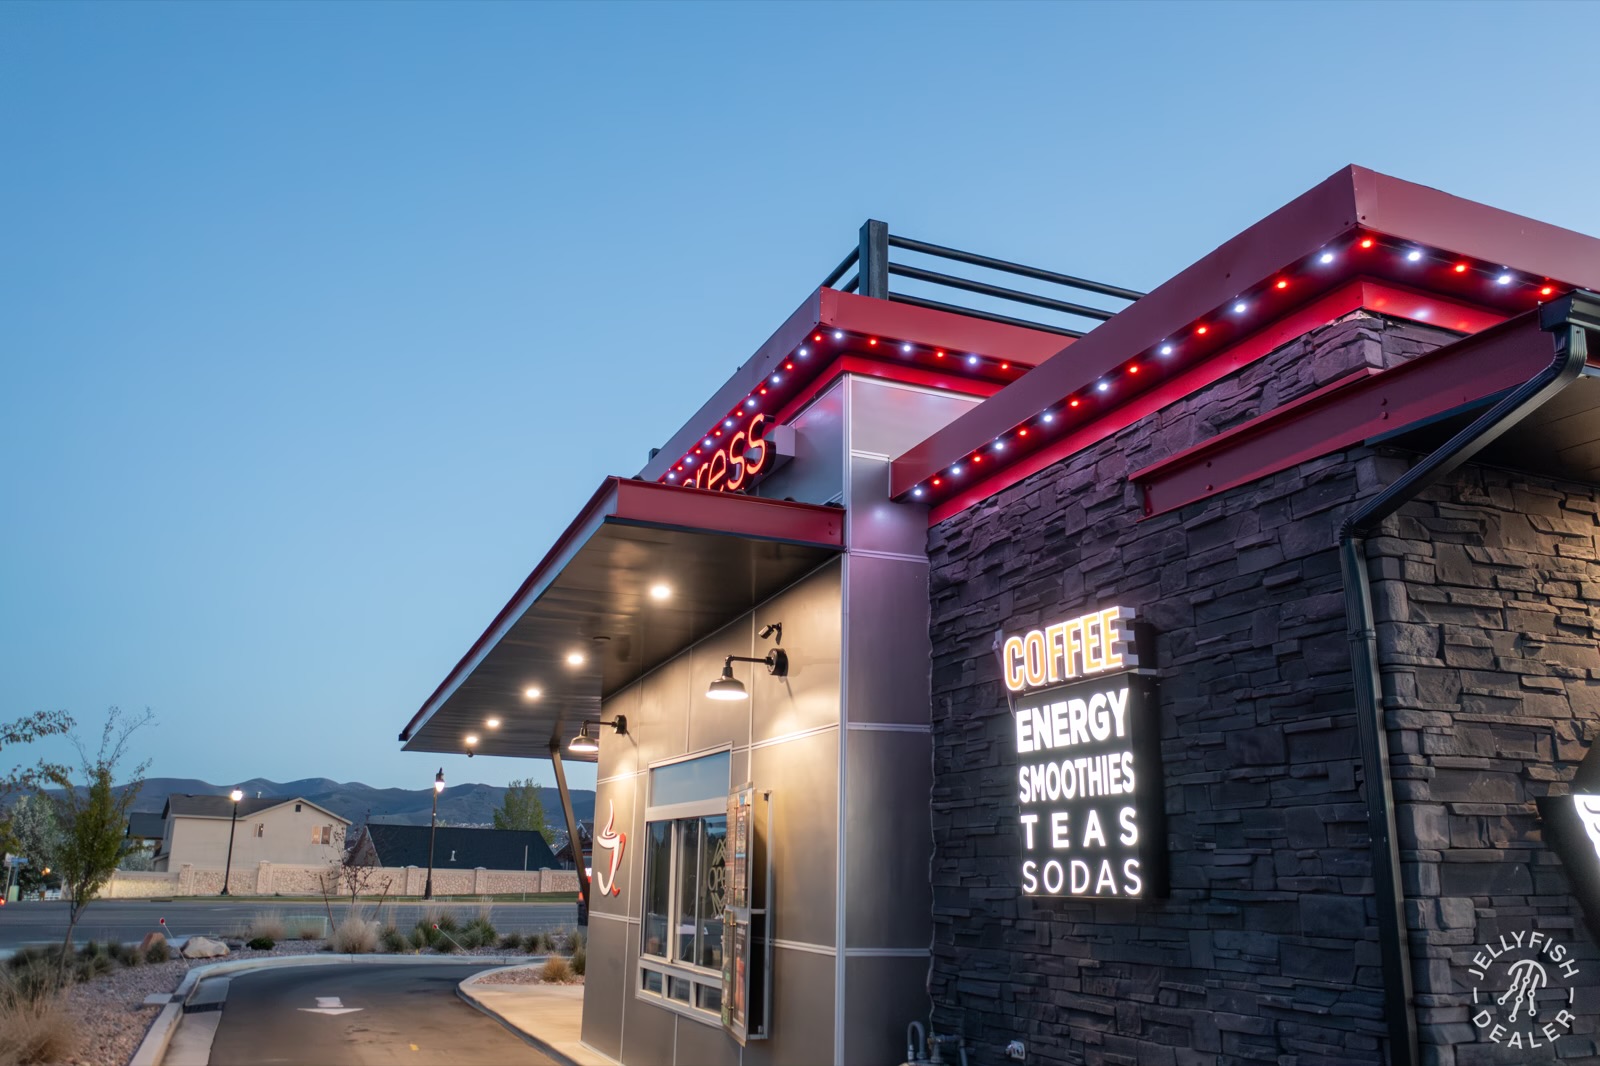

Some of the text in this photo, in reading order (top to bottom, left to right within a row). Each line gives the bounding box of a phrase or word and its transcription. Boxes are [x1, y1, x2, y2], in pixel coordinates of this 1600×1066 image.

[683, 413, 765, 492] ress
[1002, 606, 1124, 692] COFFEE
[1016, 688, 1129, 754] ENERGY
[1019, 752, 1136, 804] SMOOTHIES
[1020, 806, 1139, 850] TEAS
[1022, 858, 1142, 896] SODAS
